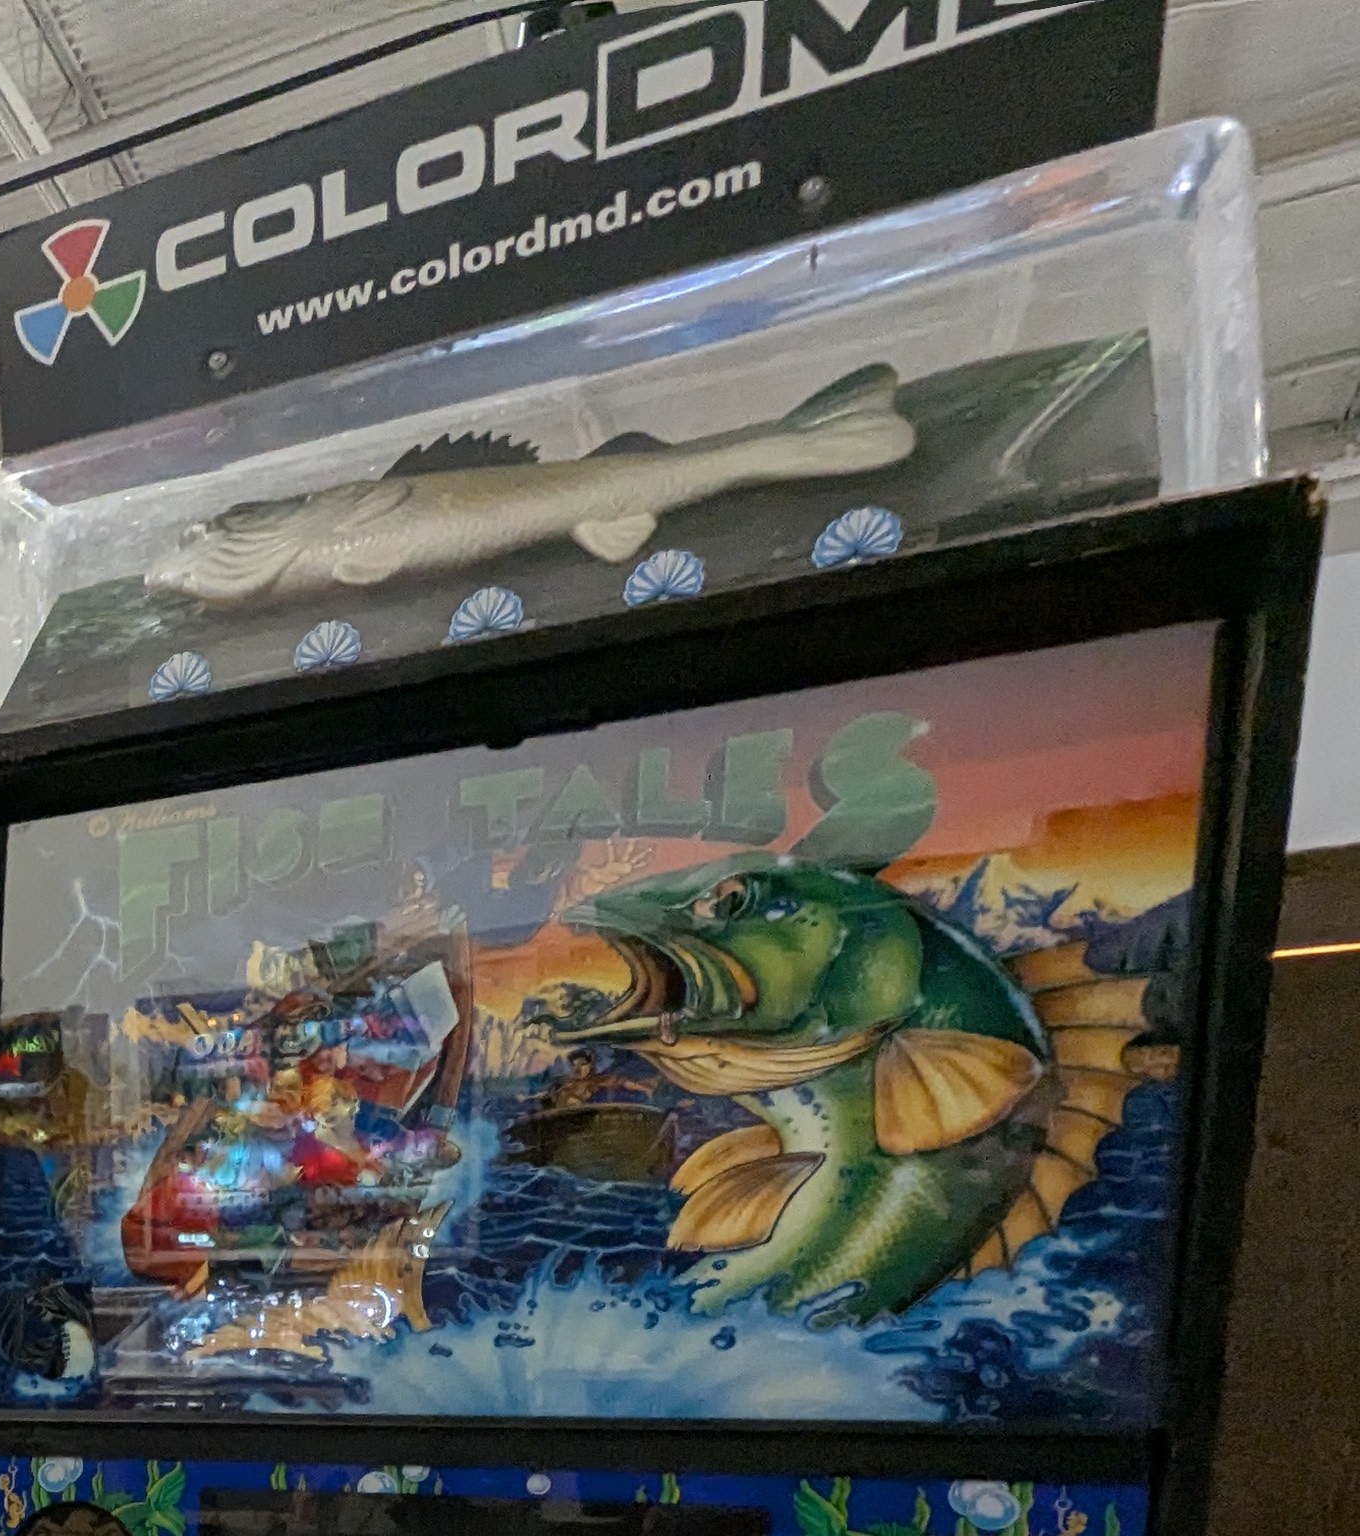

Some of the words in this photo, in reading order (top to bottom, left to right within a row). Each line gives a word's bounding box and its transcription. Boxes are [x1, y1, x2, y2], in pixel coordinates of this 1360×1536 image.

[156, 0, 1080, 294] COLORDM
[256, 154, 763, 337] www.colordmd.com
[459, 711, 938, 885] TALES
